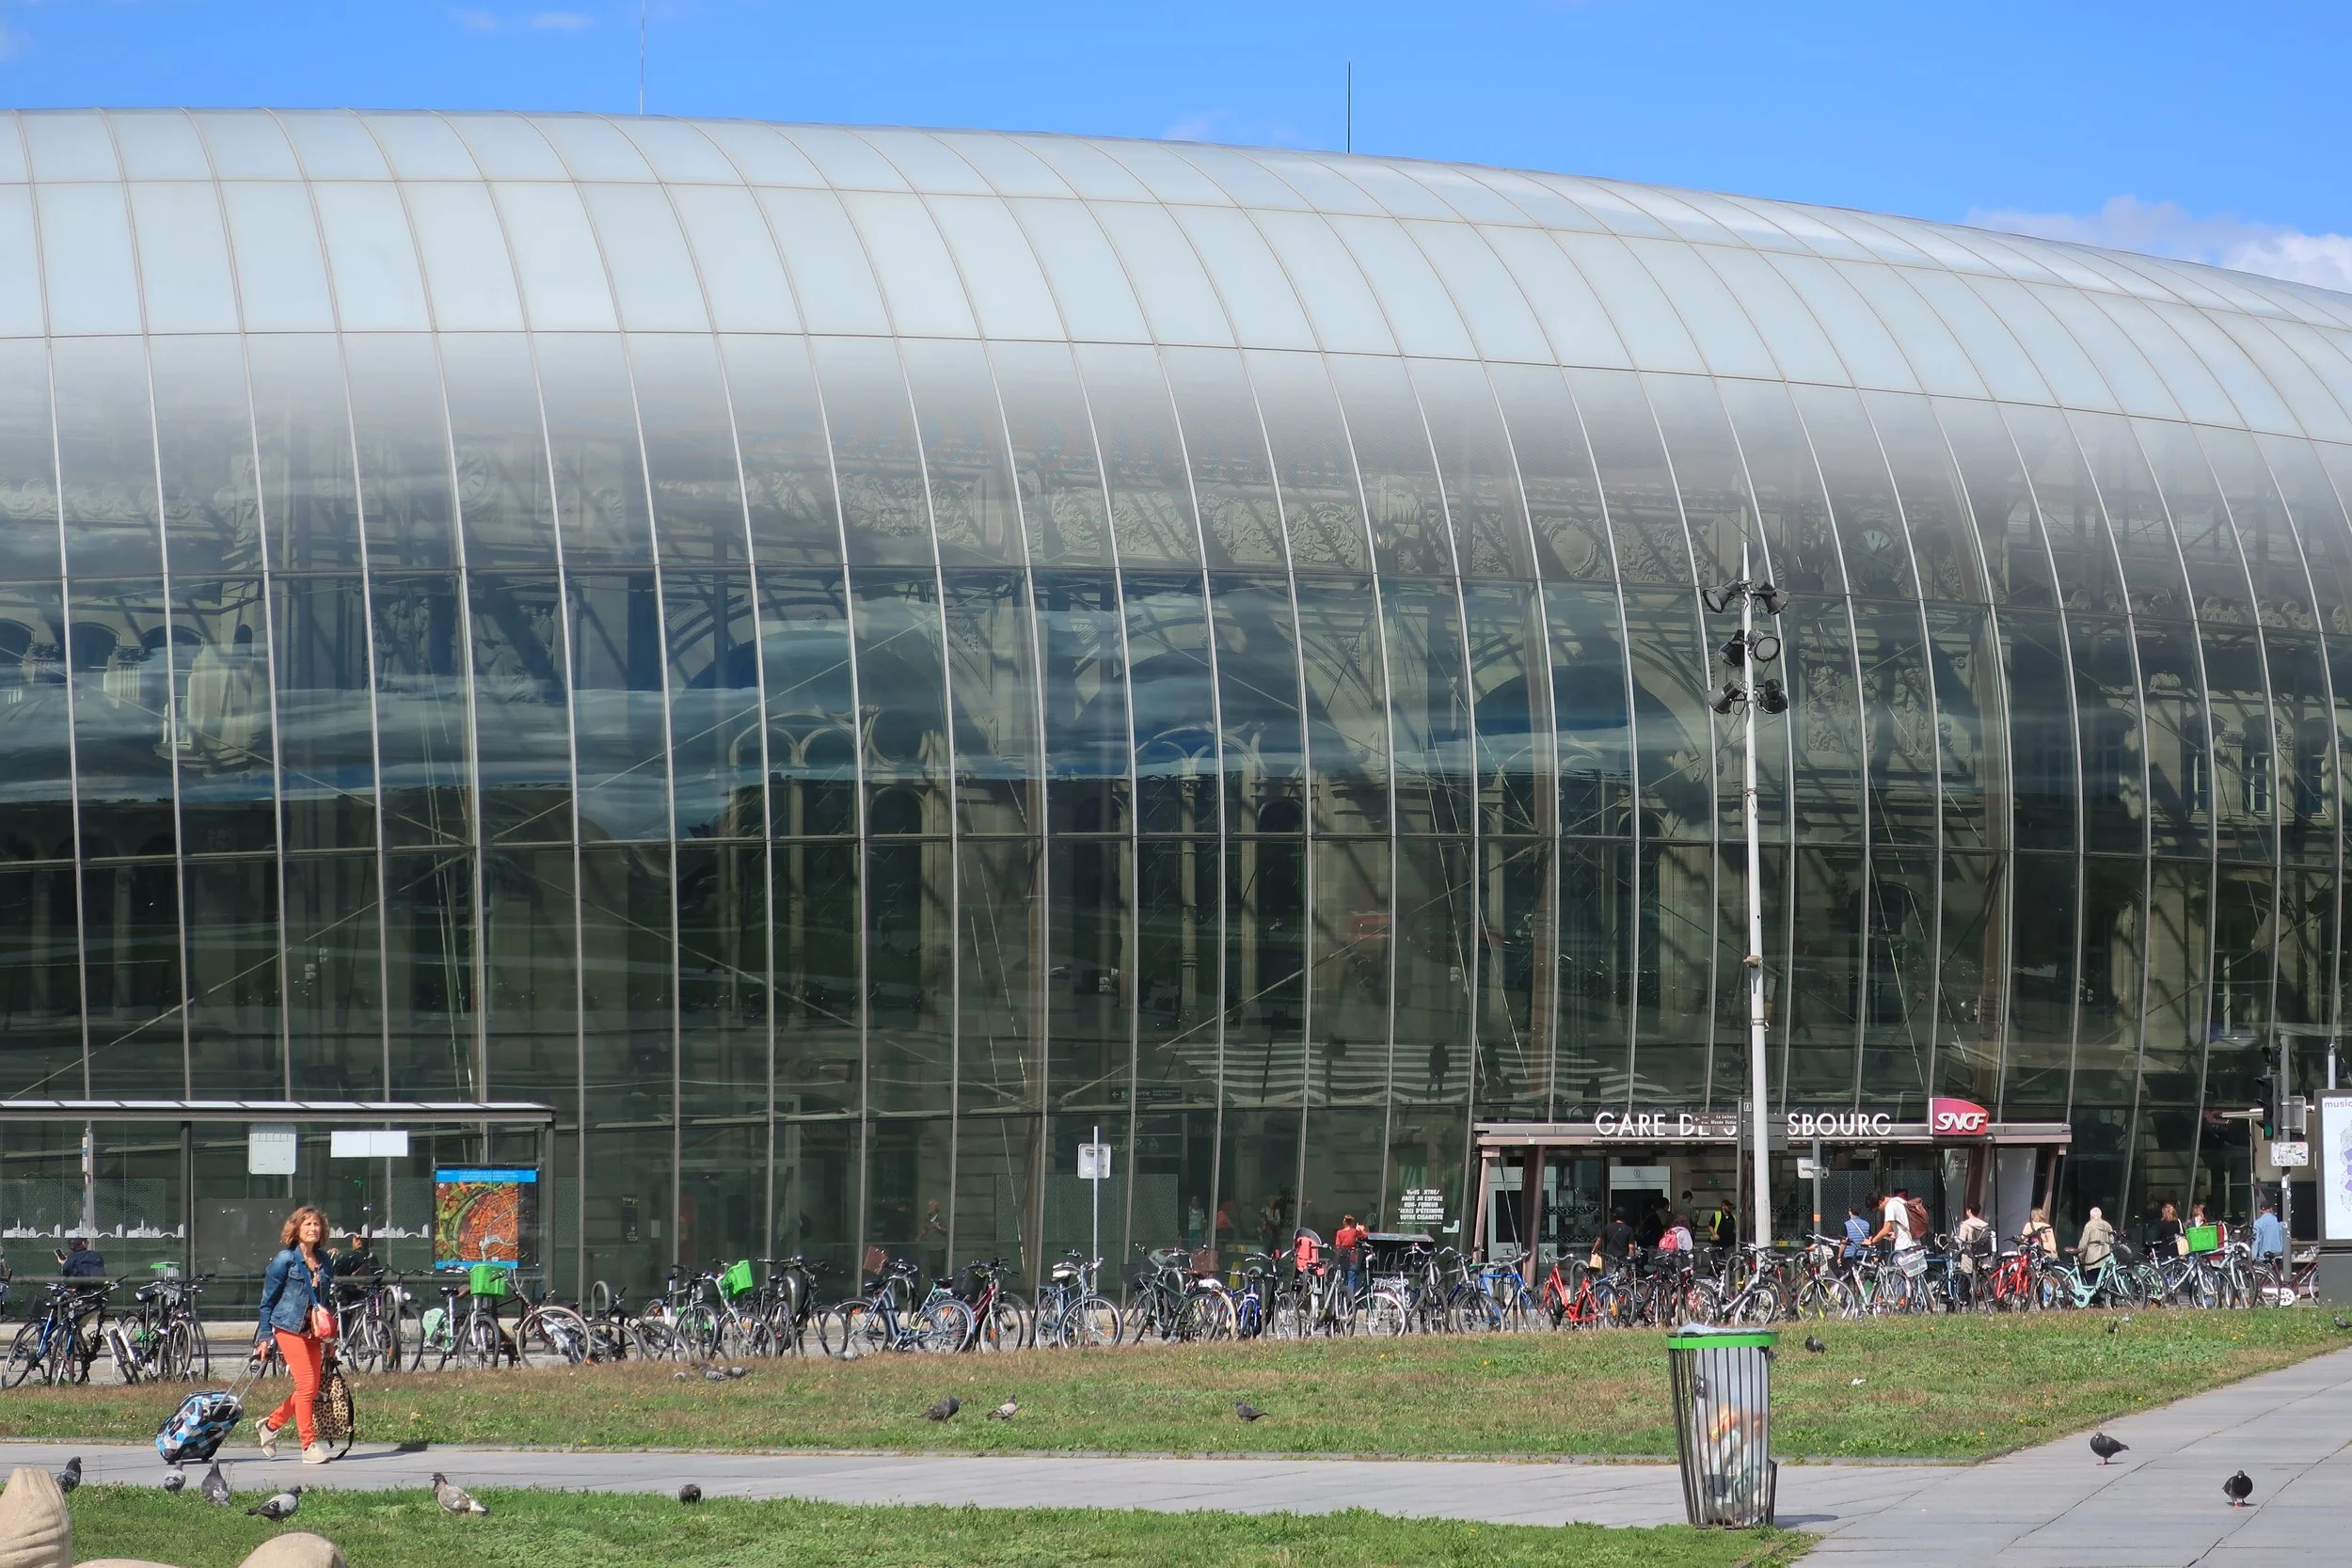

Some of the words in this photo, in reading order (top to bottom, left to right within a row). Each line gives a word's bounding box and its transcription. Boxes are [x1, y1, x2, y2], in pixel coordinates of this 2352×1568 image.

[1595, 1112, 1667, 1136] GARE
[1723, 1112, 1892, 1136] SBOURG
[1935, 1112, 1987, 1131] SNCF
